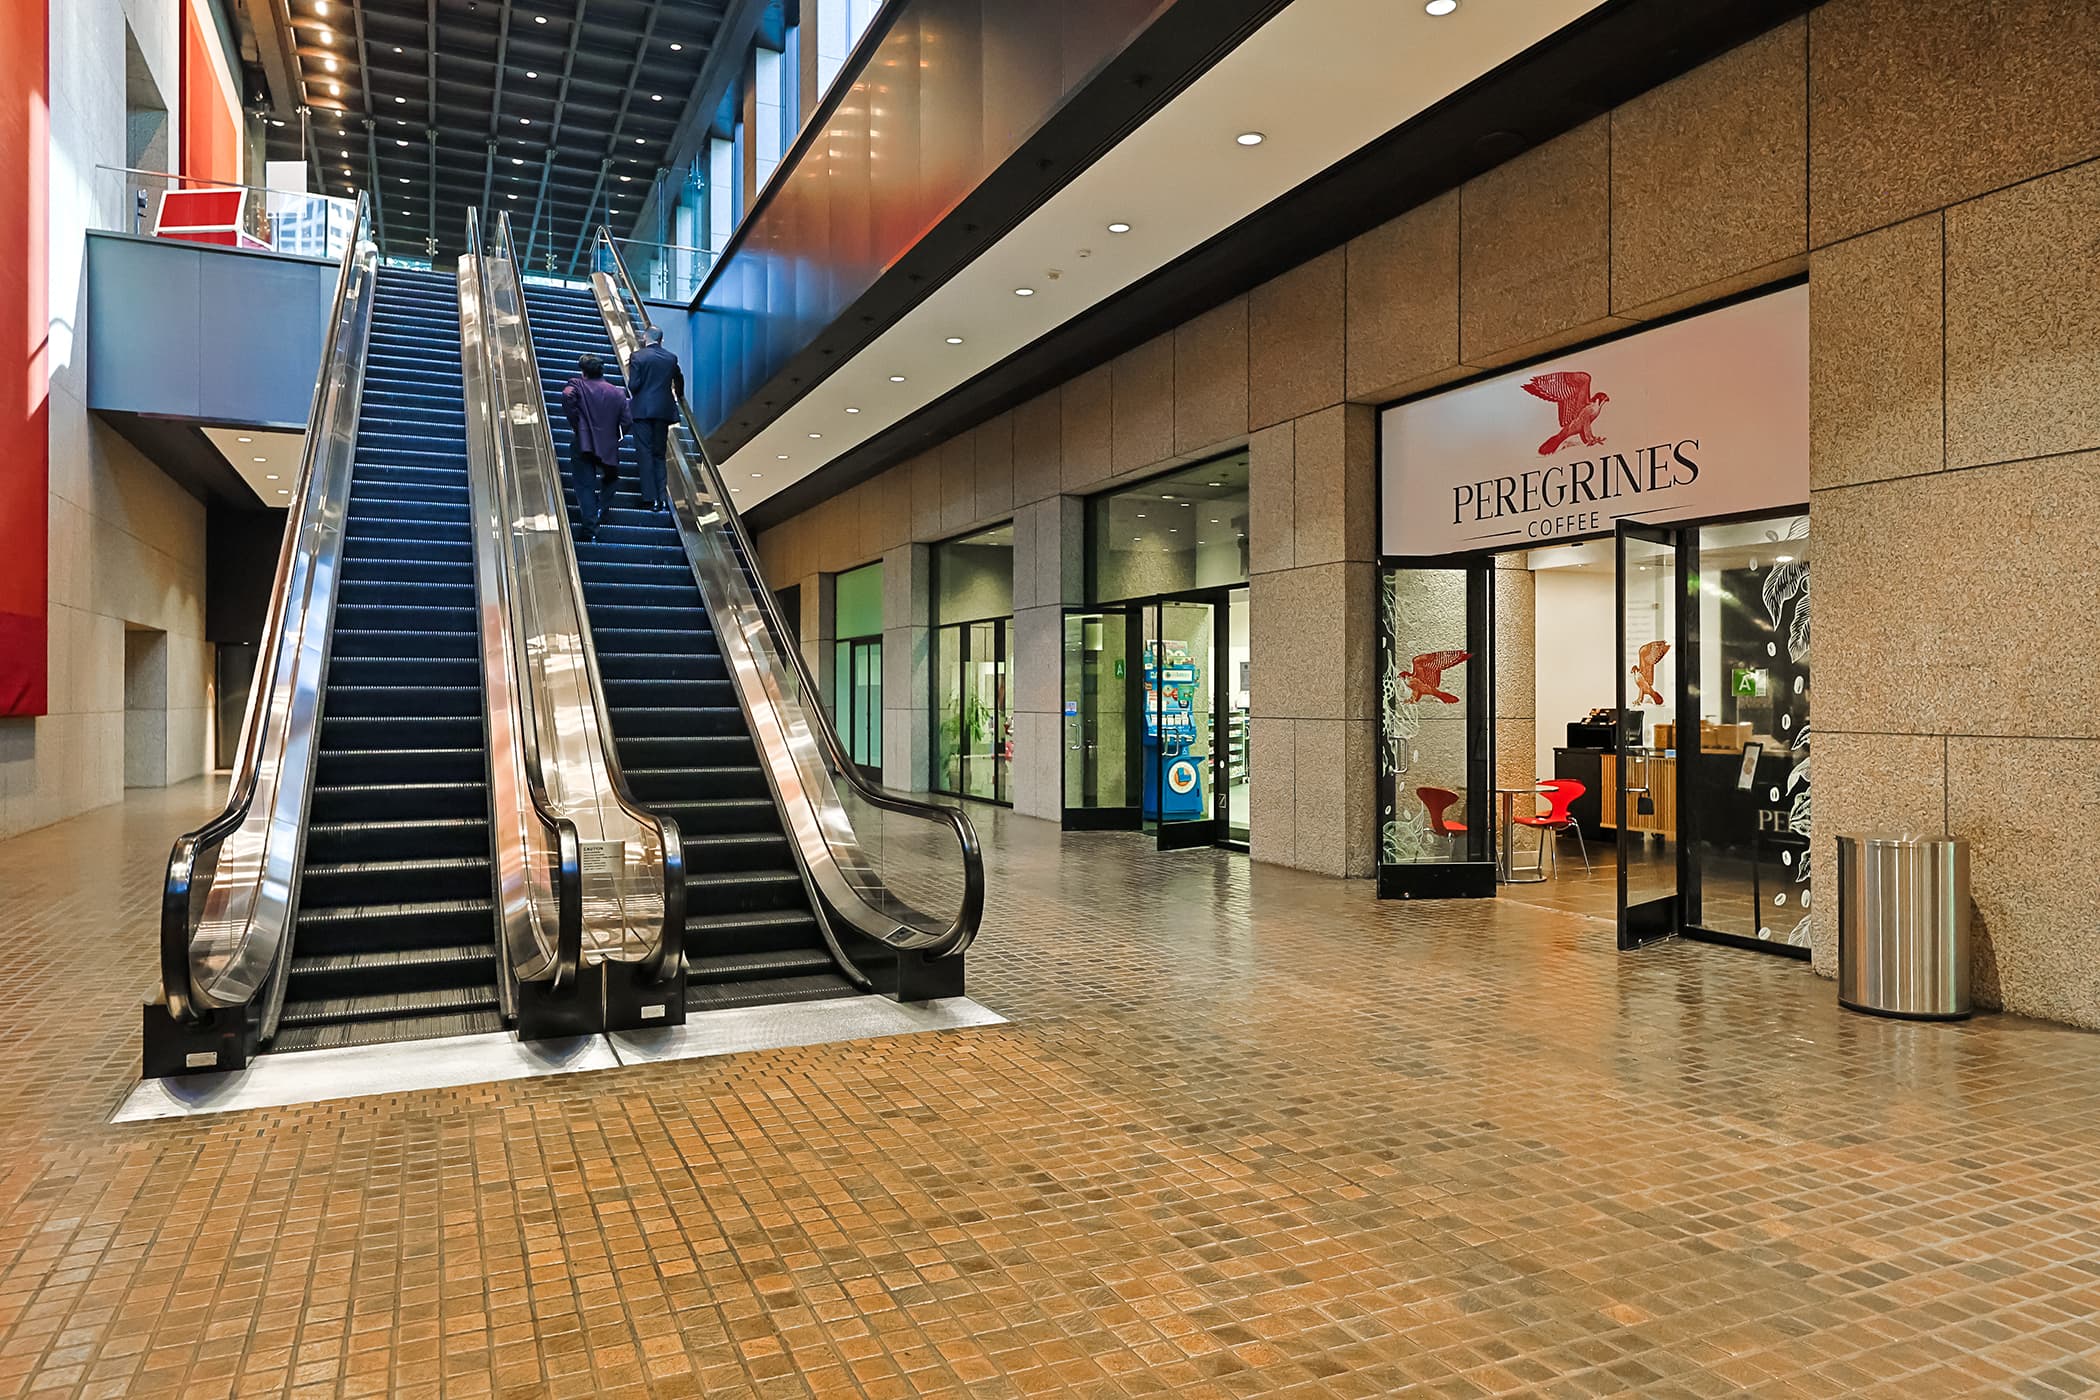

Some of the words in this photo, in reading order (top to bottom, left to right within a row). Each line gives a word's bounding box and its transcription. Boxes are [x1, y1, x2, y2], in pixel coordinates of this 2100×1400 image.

[1453, 439, 1699, 525] PEREGRINES
[1528, 511, 1599, 538] COFFEE
[1738, 673, 1752, 691] A
